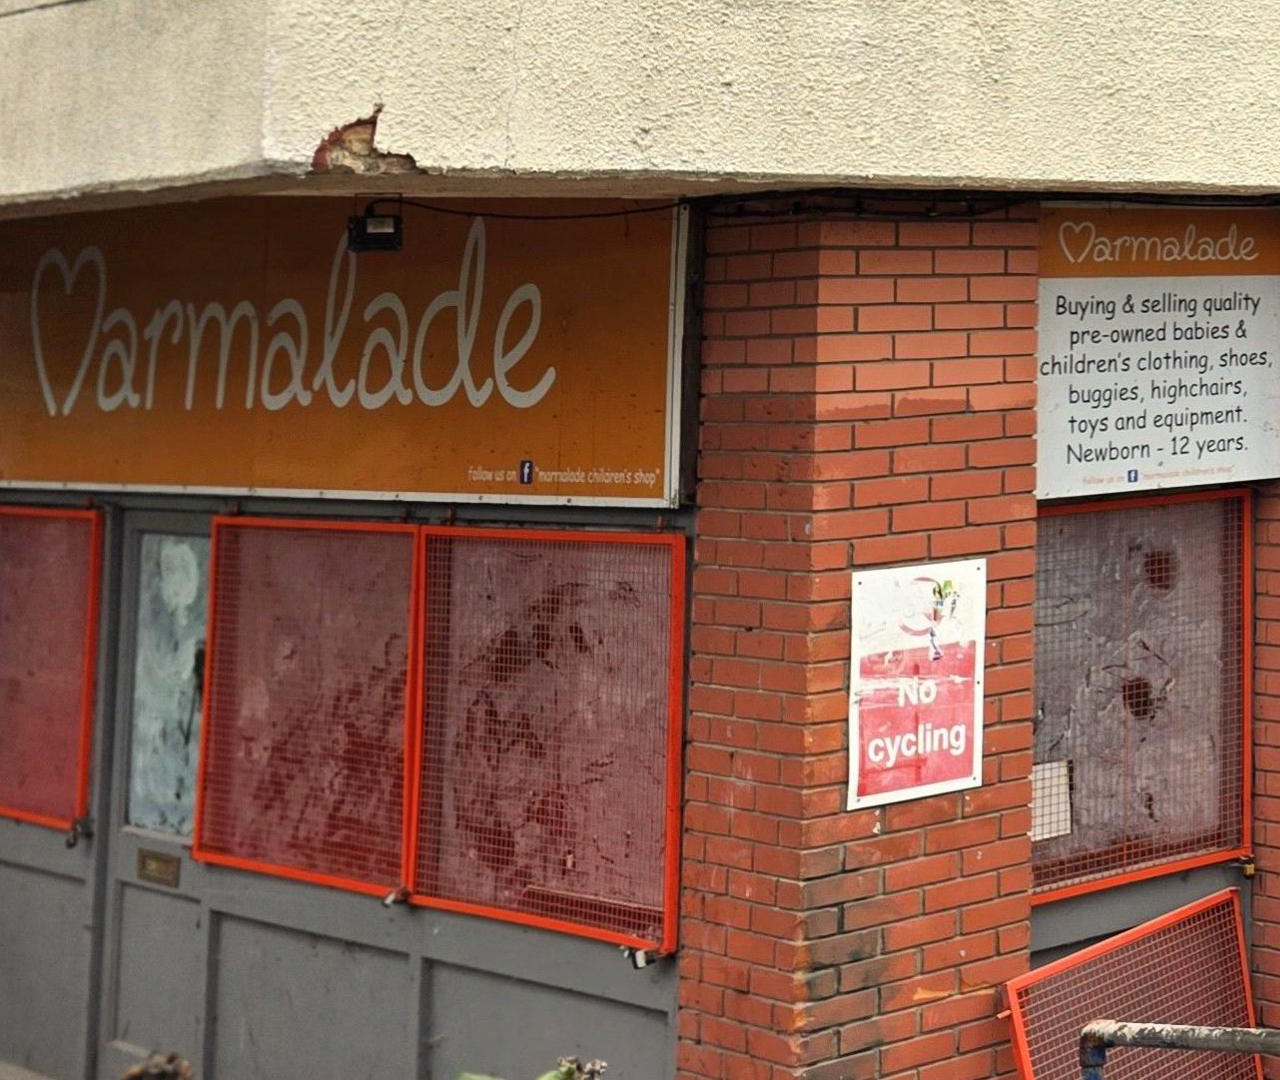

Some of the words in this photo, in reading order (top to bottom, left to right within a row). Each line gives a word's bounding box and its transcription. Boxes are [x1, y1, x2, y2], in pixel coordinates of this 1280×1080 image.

[1056, 295, 1116, 320] Buying
[1122, 294, 1135, 314] &
[1141, 292, 1197, 317] selling
[1203, 292, 1261, 315] quality
[1070, 322, 1166, 350] pre-owned
[1173, 321, 1230, 341] babies
[1235, 320, 1247, 338] &
[1040, 352, 1130, 375] children's
[1137, 350, 1214, 374] clothing,
[1219, 347, 1272, 368] shoes,
[1069, 382, 1144, 409] buggies,
[1151, 377, 1248, 404] highchairs,
[1068, 415, 1108, 438] toys
[1115, 410, 1146, 430] and
[1153, 405, 1248, 431] equipment.
[1067, 438, 1150, 464] Newborn
[1170, 436, 1189, 455] 12
[1196, 435, 1248, 459] years.
[897, 677, 937, 707] No
[868, 723, 966, 767] cycling
